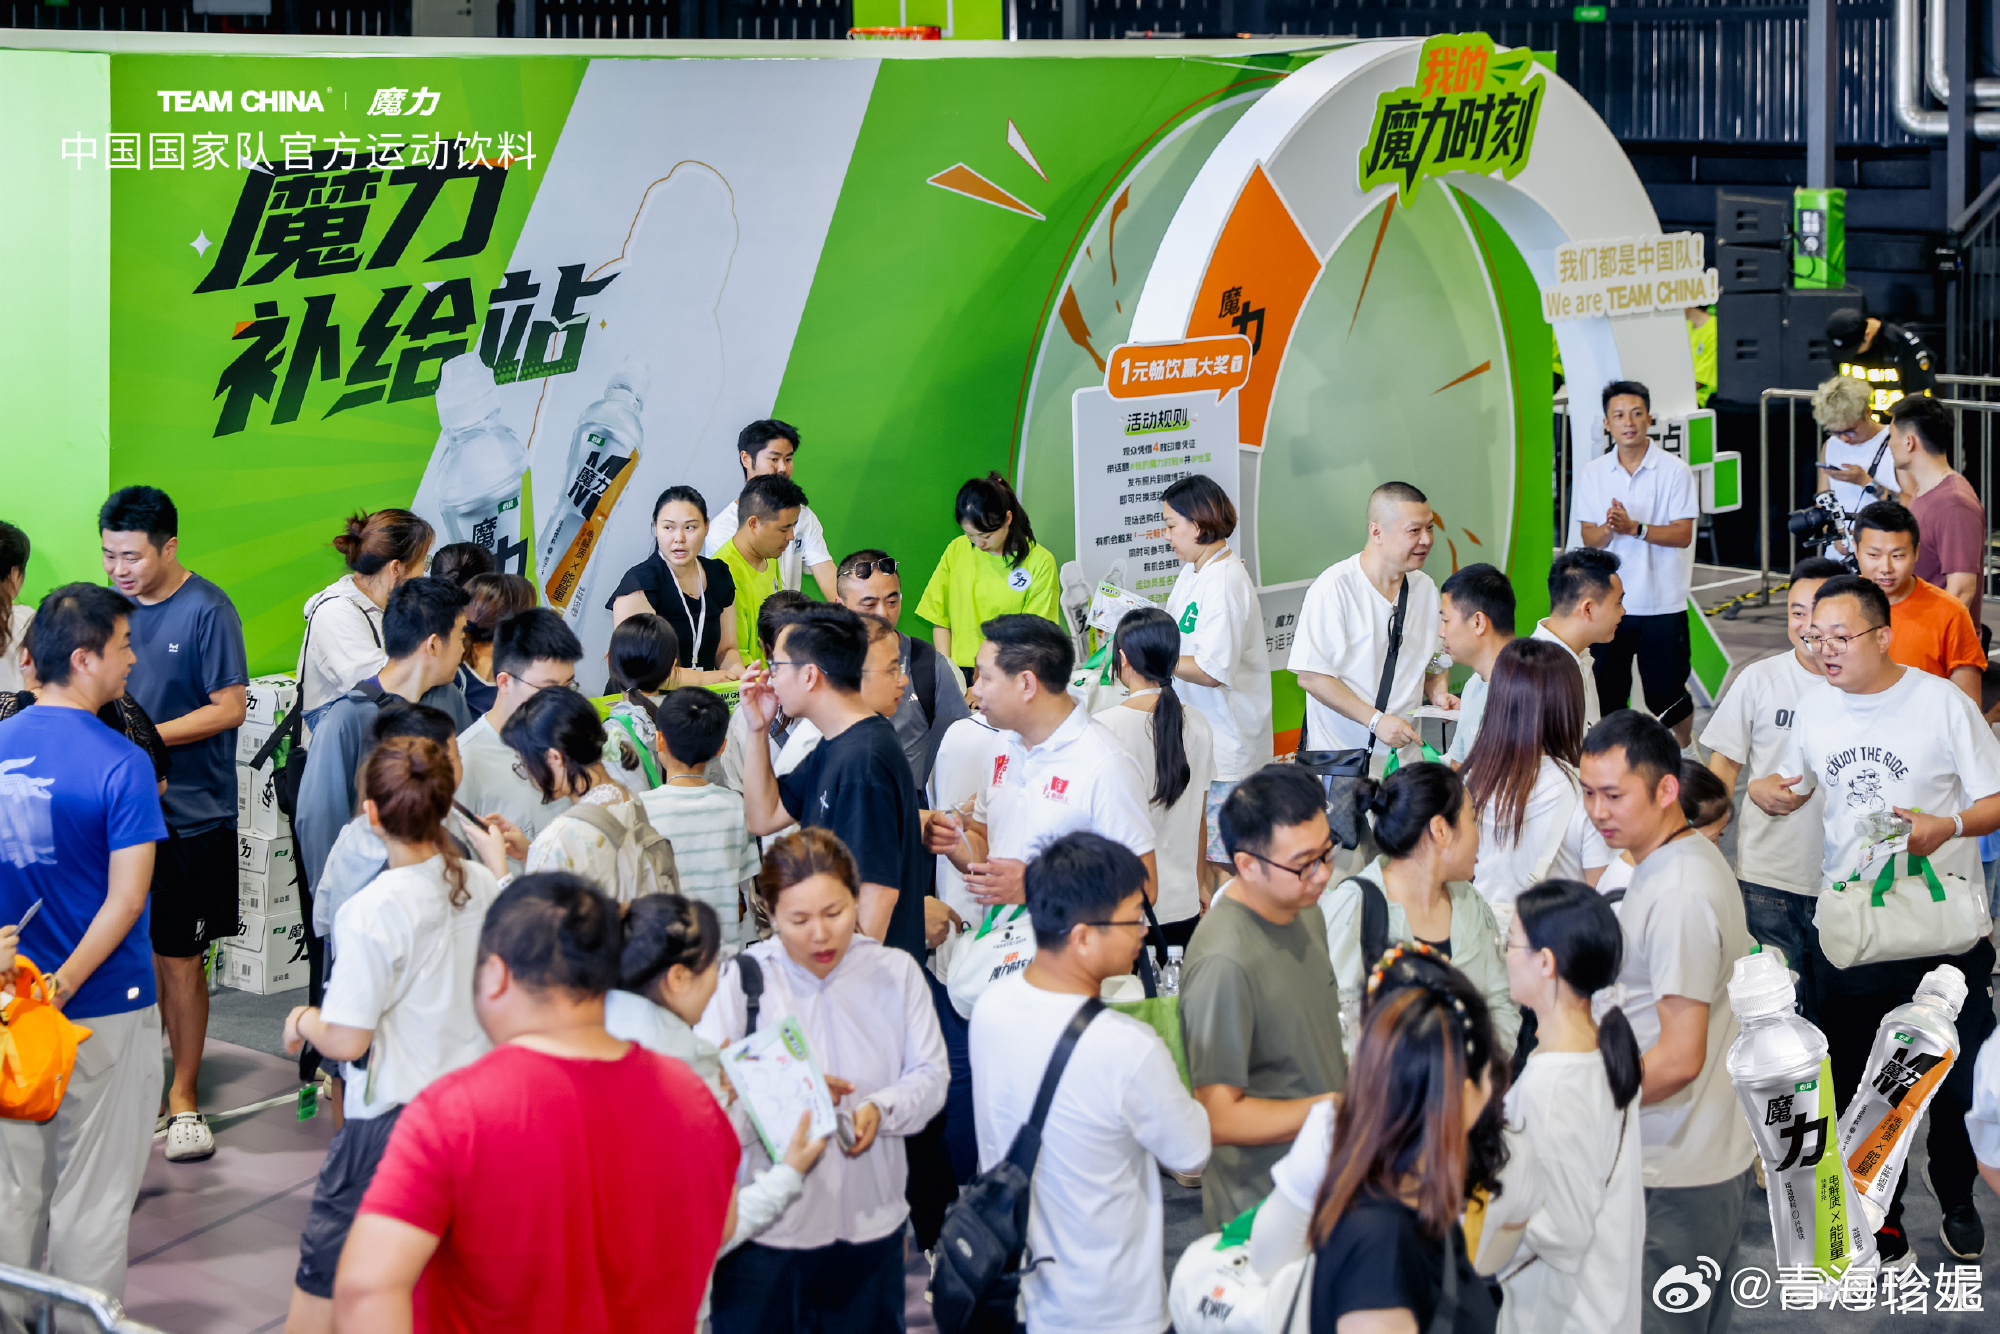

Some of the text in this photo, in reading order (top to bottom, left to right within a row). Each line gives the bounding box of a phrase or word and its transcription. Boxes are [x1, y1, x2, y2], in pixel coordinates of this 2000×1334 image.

[1420, 46, 1488, 99] 我的
[1367, 86, 1538, 194] 魔力时刻
[193, 139, 522, 295] 魔力
[1560, 239, 1700, 283] 我们都是中国队！
[1218, 286, 1266, 357] 魔力
[1546, 292, 1571, 317] We
[1576, 293, 1602, 315] are
[1606, 283, 1653, 310] TEAM
[212, 263, 622, 438] 补给站
[1121, 354, 1230, 385] 1元畅饮赢大奖
[1127, 407, 1188, 432] 活动规则
[576, 466, 611, 495] 魔力
[1827, 746, 1909, 779] ENJOY THE RIDE
